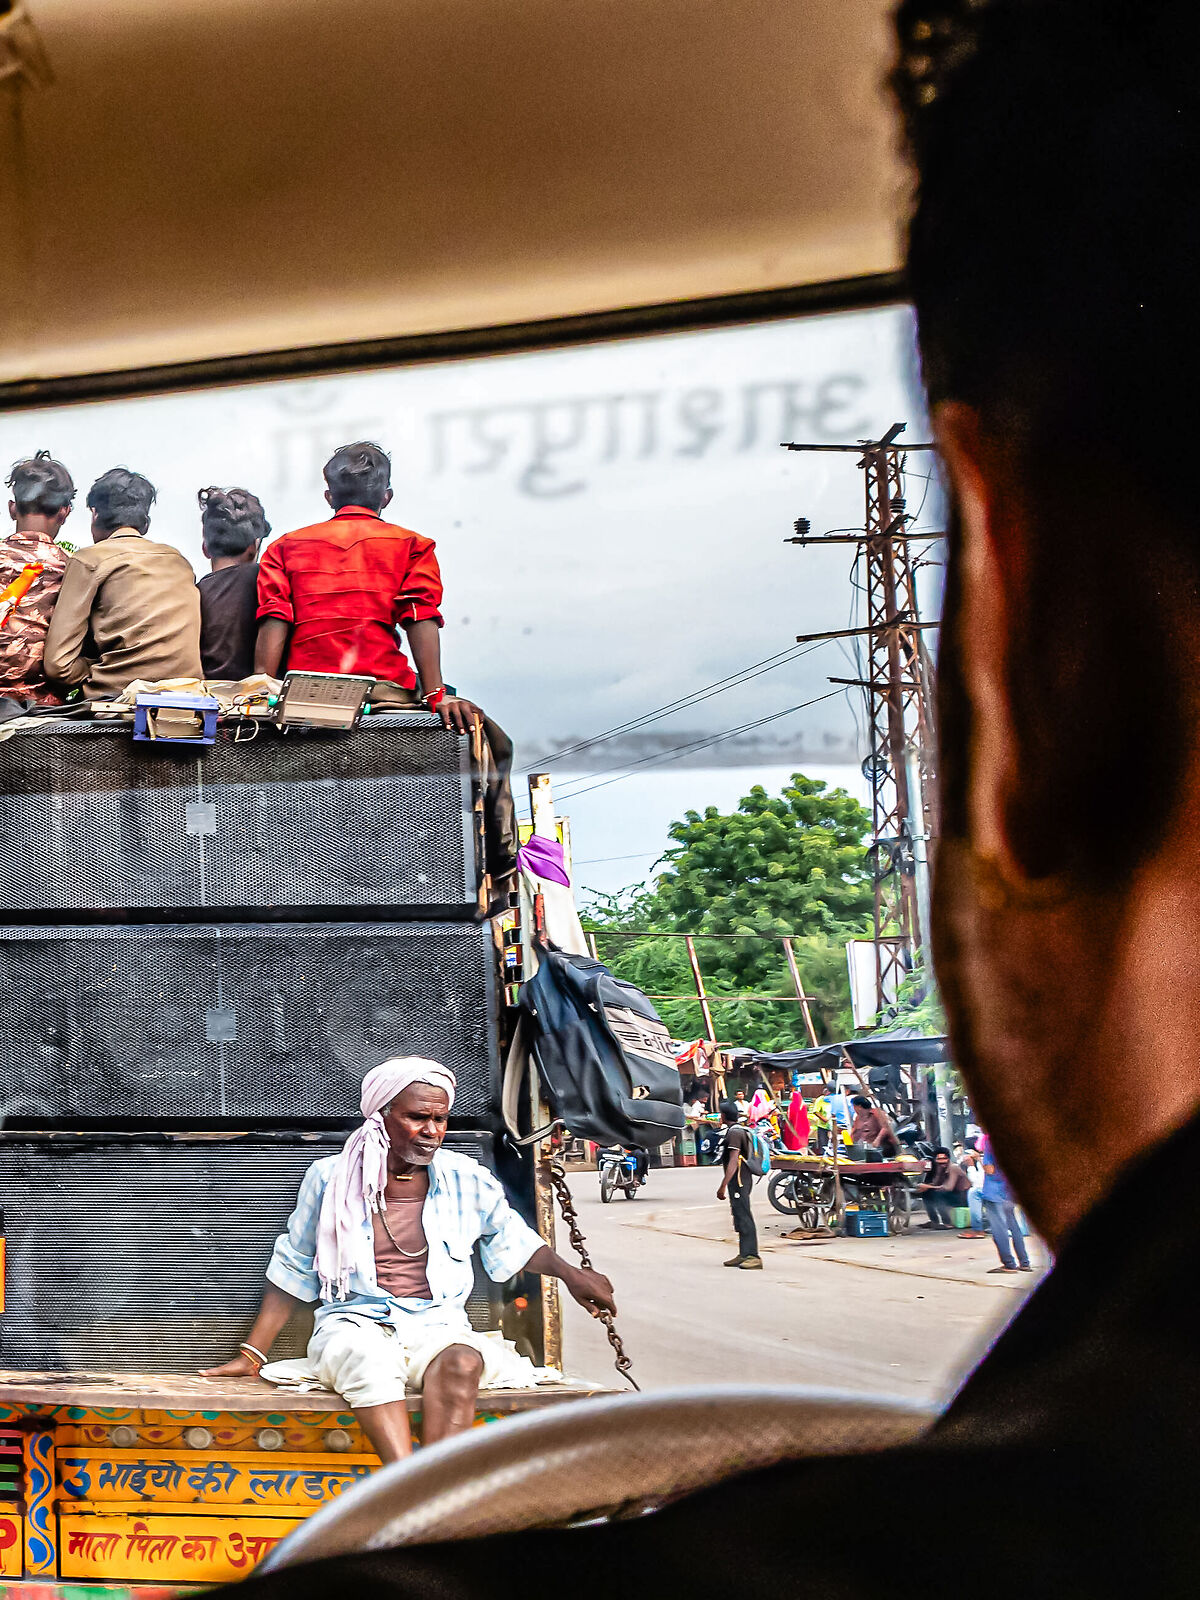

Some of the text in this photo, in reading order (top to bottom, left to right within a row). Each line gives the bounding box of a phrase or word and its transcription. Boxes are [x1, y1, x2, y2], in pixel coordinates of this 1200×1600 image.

[188, 1461, 242, 1495] की
[68, 1532, 122, 1562] माता
[126, 1521, 182, 1564] पिता
[181, 1535, 222, 1563] का
